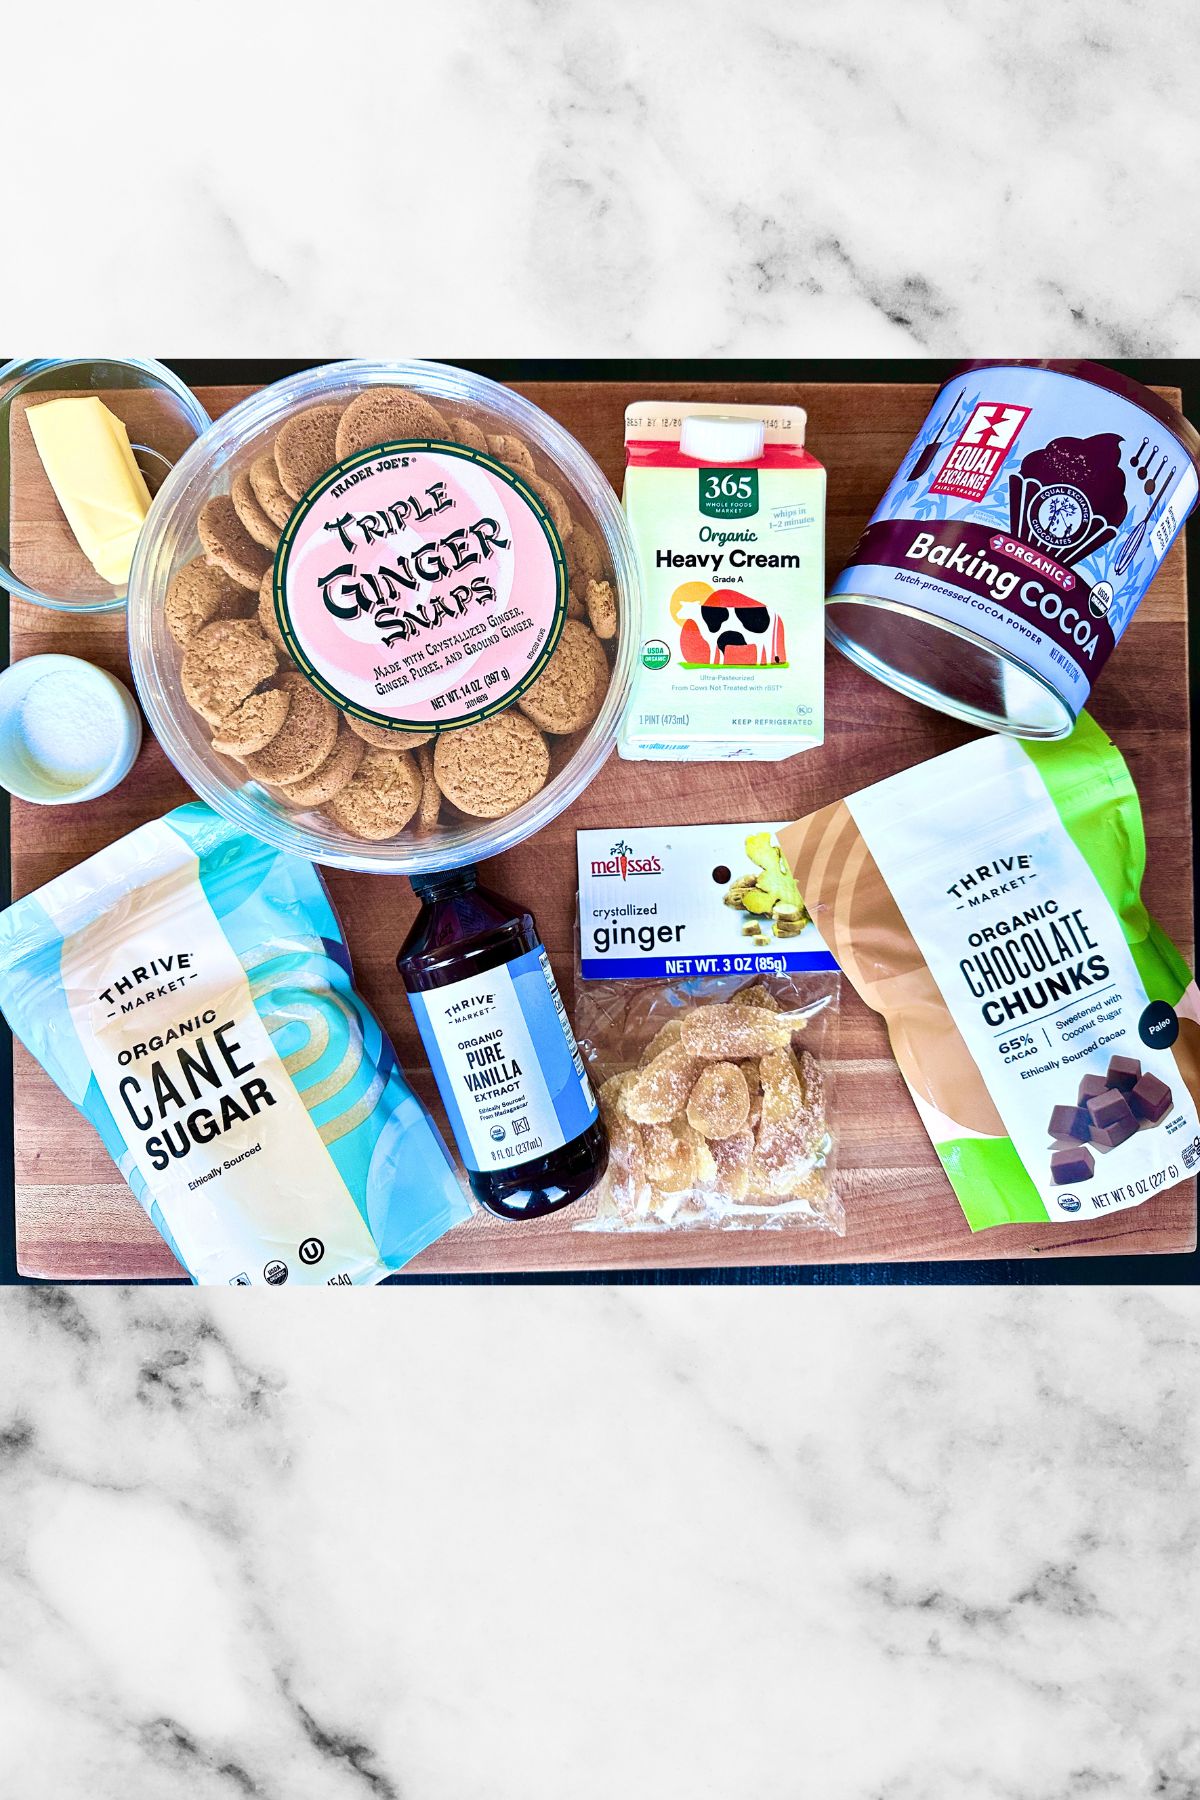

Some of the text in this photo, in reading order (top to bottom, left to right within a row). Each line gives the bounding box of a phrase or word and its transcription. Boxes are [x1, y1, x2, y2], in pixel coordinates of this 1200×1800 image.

[626, 418, 642, 427] BEST
[648, 418, 656, 427] BY
[946, 445, 1001, 475] EQUAL
[330, 457, 410, 499] TRADER JOE'S
[705, 473, 752, 499] 365
[934, 484, 981, 498] FAIRLY TRADED
[938, 469, 991, 492] EXCHANGE
[324, 482, 456, 553] TRIPLE
[773, 509, 797, 520] whips
[1040, 488, 1089, 523] EQUAL EXCHANGE
[784, 516, 815, 527] minutes
[1032, 519, 1072, 544] CHOCOLATES
[699, 526, 758, 547] Organic
[317, 517, 511, 620] GINGER
[656, 549, 800, 572] Heavy Cream
[1004, 543, 1064, 582] ORGANIC
[894, 572, 1042, 646] Dutch-processed COCOA POWDER
[905, 532, 1099, 660] Baking COCOA
[1097, 587, 1110, 604] USDA
[374, 577, 497, 648] SNAPS
[1049, 647, 1060, 661] NET
[430, 694, 447, 711] NET
[445, 689, 462, 703] WT.
[460, 684, 472, 697] 14
[470, 679, 483, 693] OZ
[483, 670, 500, 689] (397
[639, 714, 690, 726] 1 PINT (473mL)
[591, 855, 662, 878] melissa's
[947, 855, 1030, 899] THRIVE
[968, 876, 1026, 907] MARKET
[593, 903, 657, 920] crystallized
[968, 900, 1059, 947] ORGANIC
[593, 919, 686, 952] ginger
[666, 956, 787, 974] NET WT. 3 OZ (85g)
[959, 909, 1098, 998] CHOCOLATE
[99, 953, 191, 1005] THRIVE
[982, 955, 1110, 1026] CHUNKS
[120, 976, 186, 1014] MARKET
[445, 994, 494, 1018] THRIVE
[455, 1008, 490, 1024] MARKET
[1055, 993, 1123, 1030] Sweetened with
[1061, 1008, 1123, 1042] Coconut Sugar
[1148, 1017, 1171, 1035] Paleo
[117, 1009, 217, 1066] ORGANIC
[458, 1029, 504, 1050] ORGANIC
[998, 1033, 1034, 1054] 65%
[466, 1042, 506, 1070] PURE
[1004, 1046, 1038, 1064] CACAO
[1020, 1028, 1126, 1080] Ethically Sourced Cacao
[119, 1020, 256, 1131] CANE
[463, 1059, 523, 1093] VANILLA
[474, 1081, 521, 1103] EXTRACT
[478, 1095, 526, 1114] Ethically Sourced
[146, 1077, 277, 1171] SUGAR
[479, 1101, 529, 1121] From Madagascar
[491, 1151, 496, 1161] 8
[497, 1149, 505, 1159] FL
[505, 1146, 515, 1157] OZ
[515, 1136, 543, 1156] (237mL)
[188, 1142, 262, 1191] Ethically Sourced
[1091, 1193, 1112, 1209] NET
[1111, 1188, 1126, 1203] WT
[1127, 1185, 1135, 1198] 8
[1135, 1180, 1149, 1194] OZ
[1148, 1170, 1167, 1189] (227
[1167, 1164, 1179, 1178] G)
[267, 1265, 282, 1276] USDA
